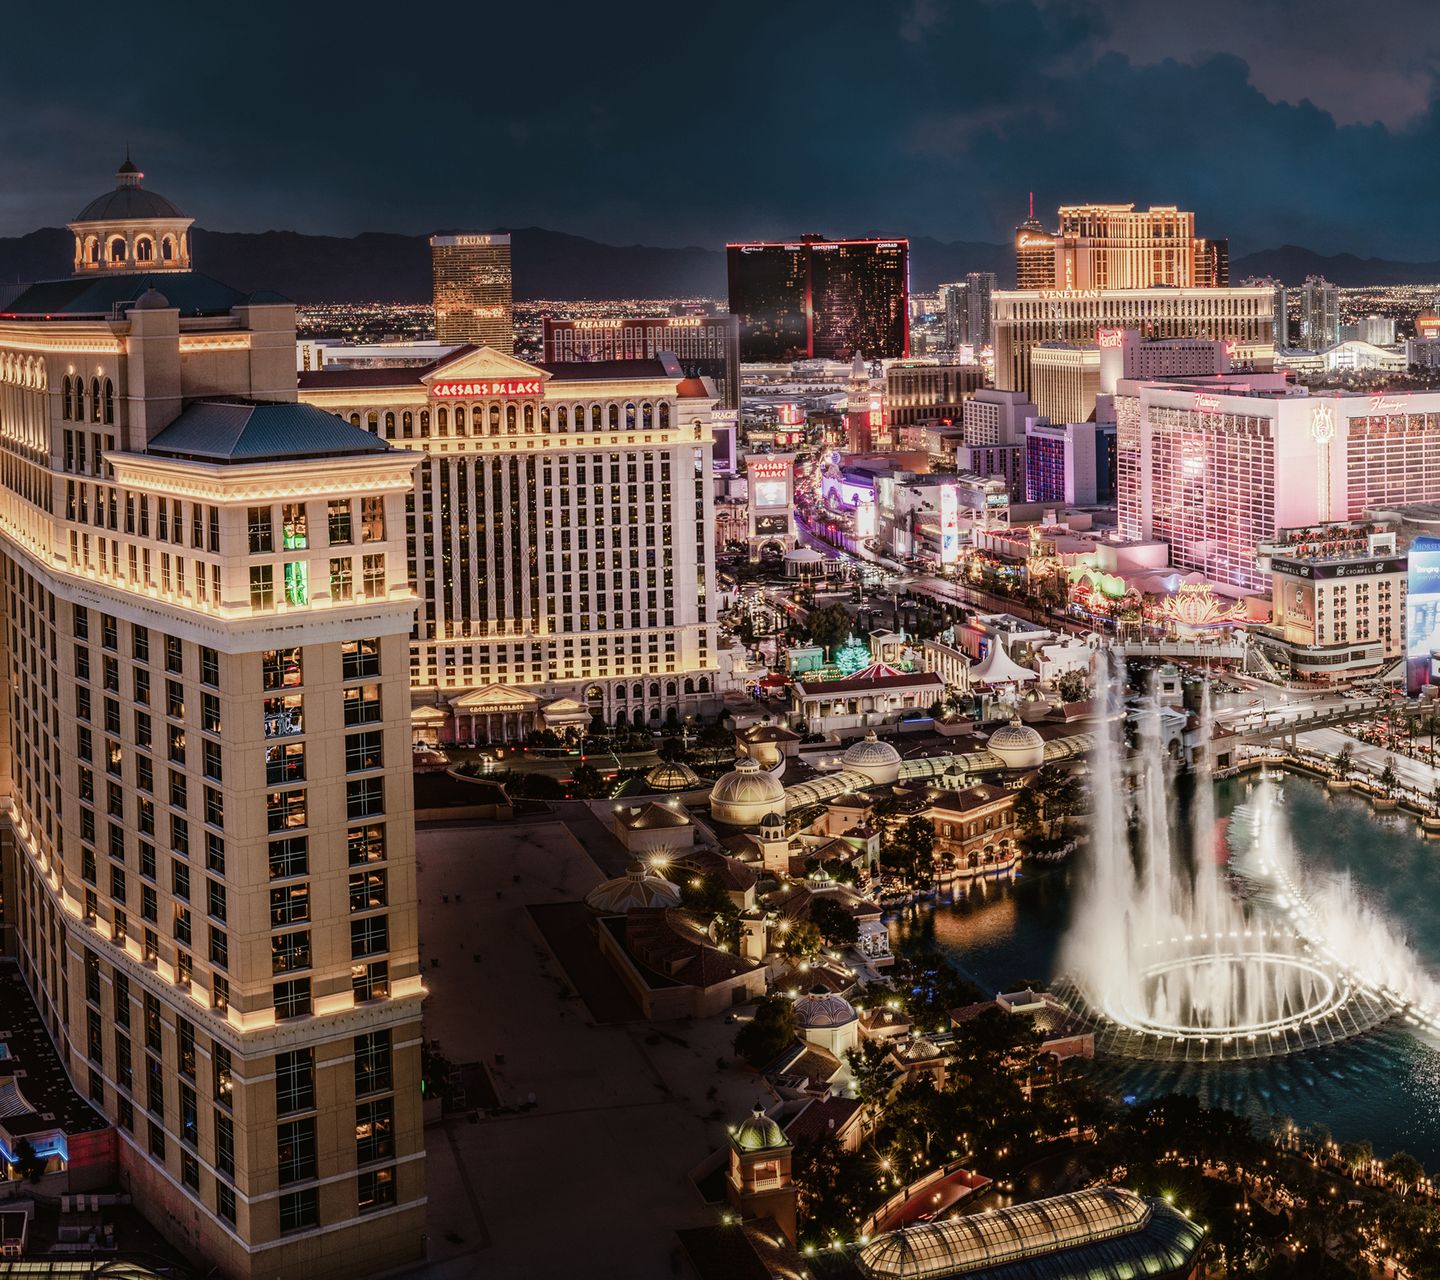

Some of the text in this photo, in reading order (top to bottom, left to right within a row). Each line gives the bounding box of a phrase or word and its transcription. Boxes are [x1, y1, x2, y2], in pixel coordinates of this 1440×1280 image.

[456, 236, 491, 245] TRUMP
[1065, 258, 1073, 290] PALA
[1042, 290, 1100, 299] VENETIAN
[574, 319, 702, 328] TREASURE ISLAND
[433, 382, 540, 396] CAESARS PALACE
[1369, 396, 1408, 411] Flamingo
[711, 411, 737, 420] IRAGE
[753, 463, 788, 471] CAESARS
[754, 470, 786, 478] PALACE
[1272, 563, 1300, 575] CROMWELL
[1345, 568, 1375, 576] CROMWELL
